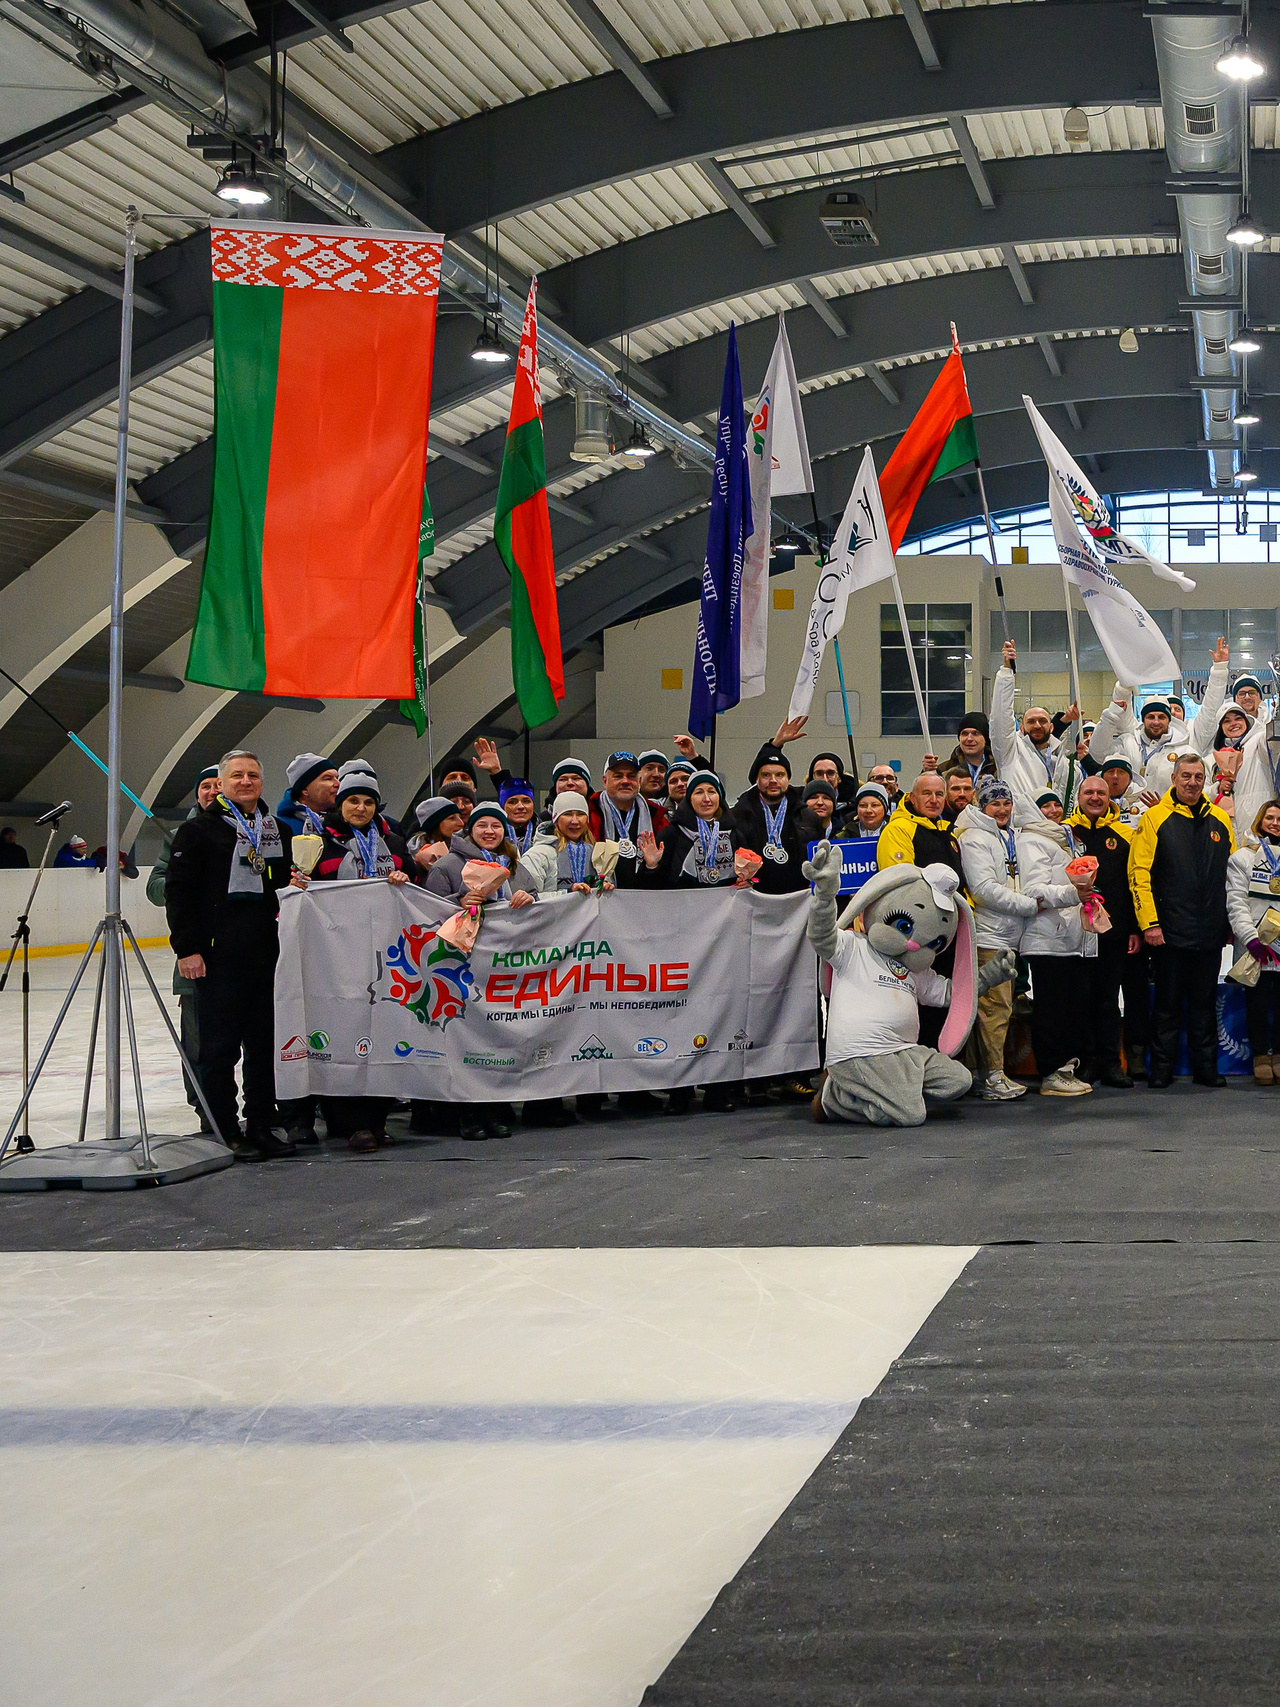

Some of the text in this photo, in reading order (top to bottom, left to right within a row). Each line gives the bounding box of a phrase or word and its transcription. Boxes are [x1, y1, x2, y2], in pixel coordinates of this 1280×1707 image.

[491, 940, 614, 968] КОМАНДА
[485, 963, 690, 1009] ЕДИНЫЕ
[486, 1012, 519, 1022] КОГДА
[521, 1010, 540, 1020] МЫ
[542, 1005, 575, 1018] ЕДИНЫ
[589, 1001, 608, 1010] МЫ
[611, 998, 688, 1010] НЕПОБЕДИМЫ!
[463, 1056, 515, 1066] ВОСТОЧНЫЙ
